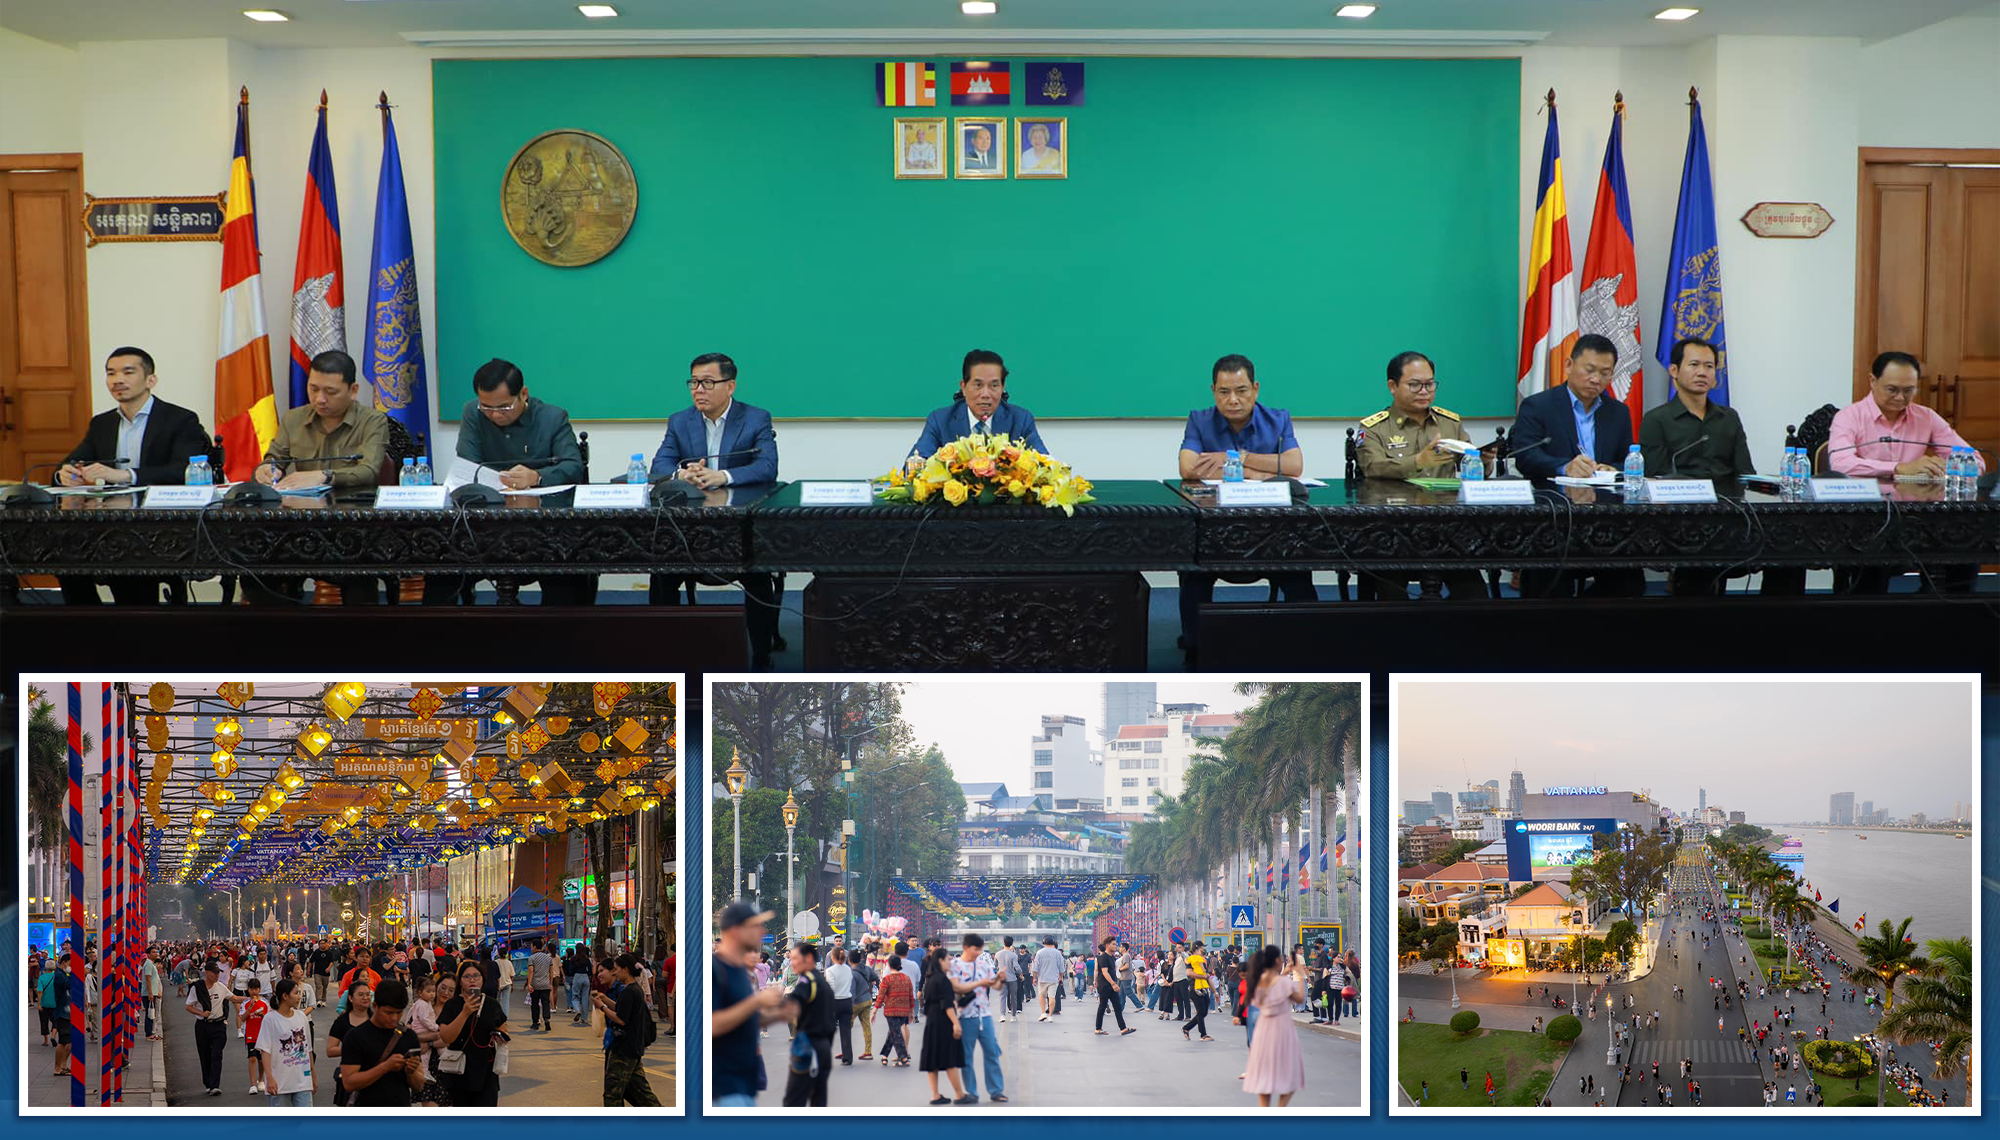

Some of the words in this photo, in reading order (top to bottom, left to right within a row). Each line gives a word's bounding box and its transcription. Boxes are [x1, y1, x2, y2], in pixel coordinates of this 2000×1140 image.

[1544, 785, 1607, 796] VATTANAC
[1527, 823, 1555, 831] WOORI
[1556, 822, 1581, 831] BANK
